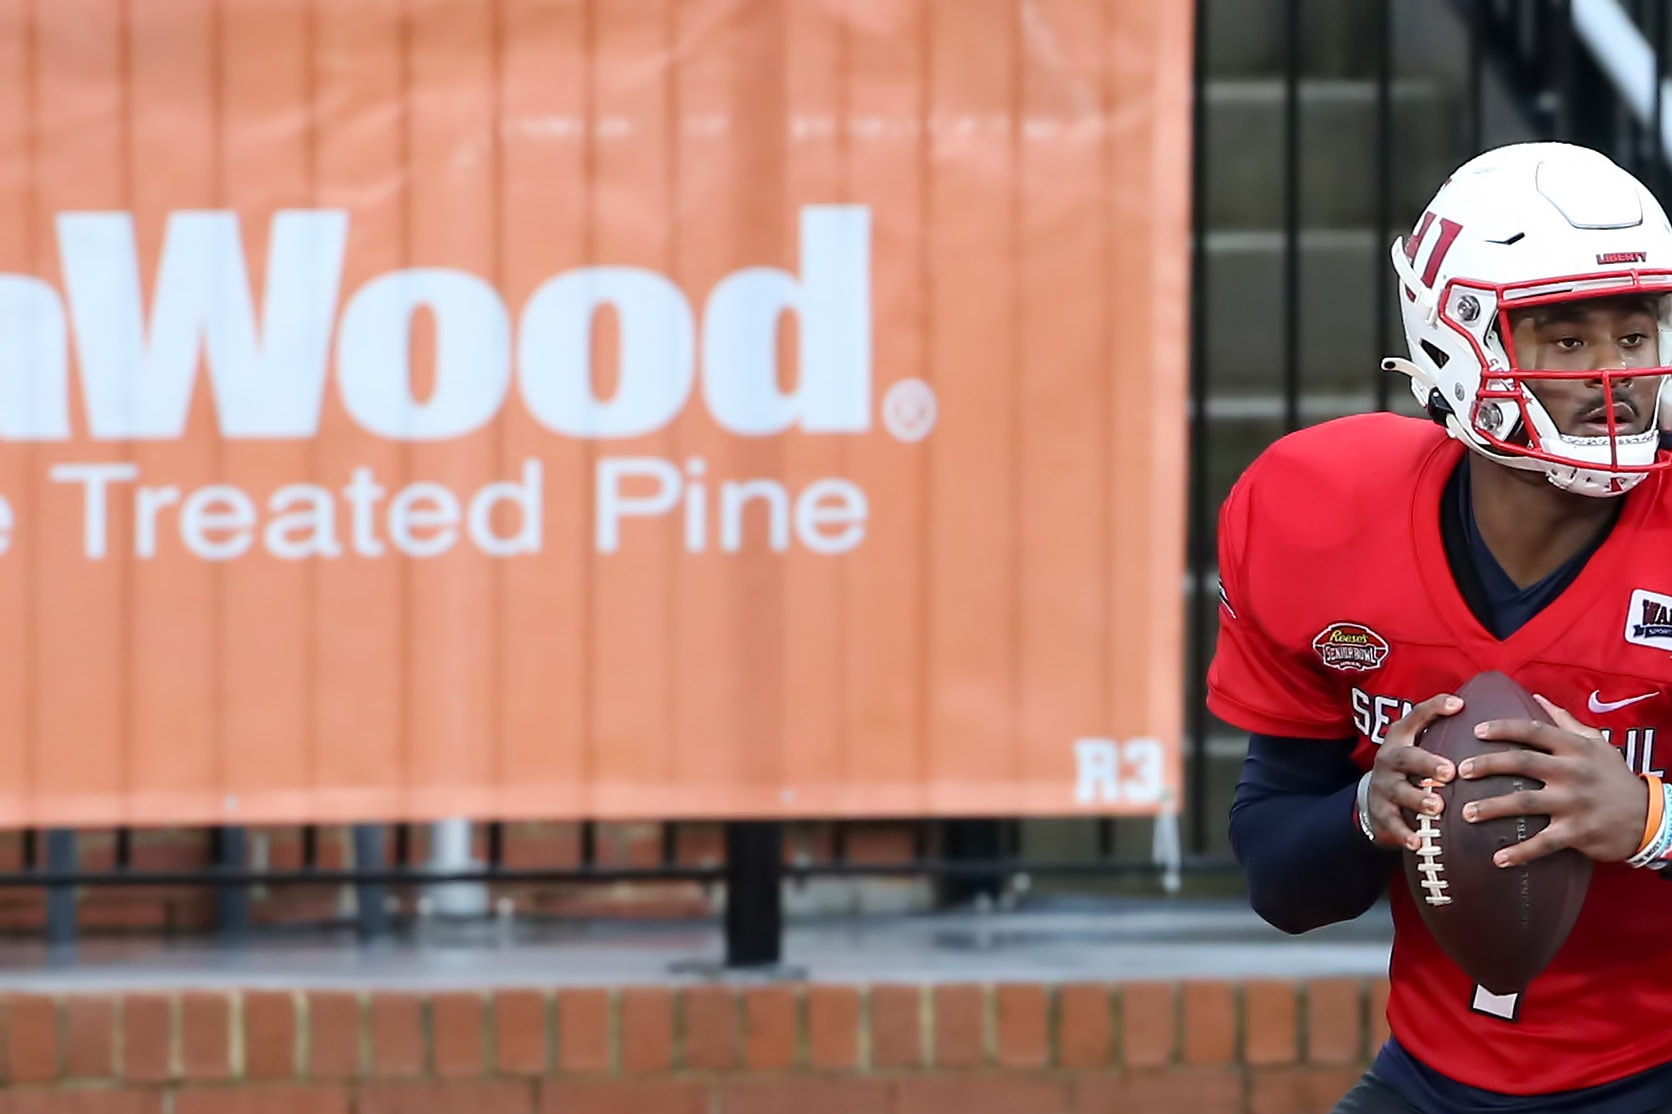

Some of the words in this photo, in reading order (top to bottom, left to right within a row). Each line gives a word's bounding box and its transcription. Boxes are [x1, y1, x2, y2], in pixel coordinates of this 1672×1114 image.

[49, 457, 544, 560] Treated
[593, 457, 869, 554] Pine
[1074, 738, 1163, 804] R3
